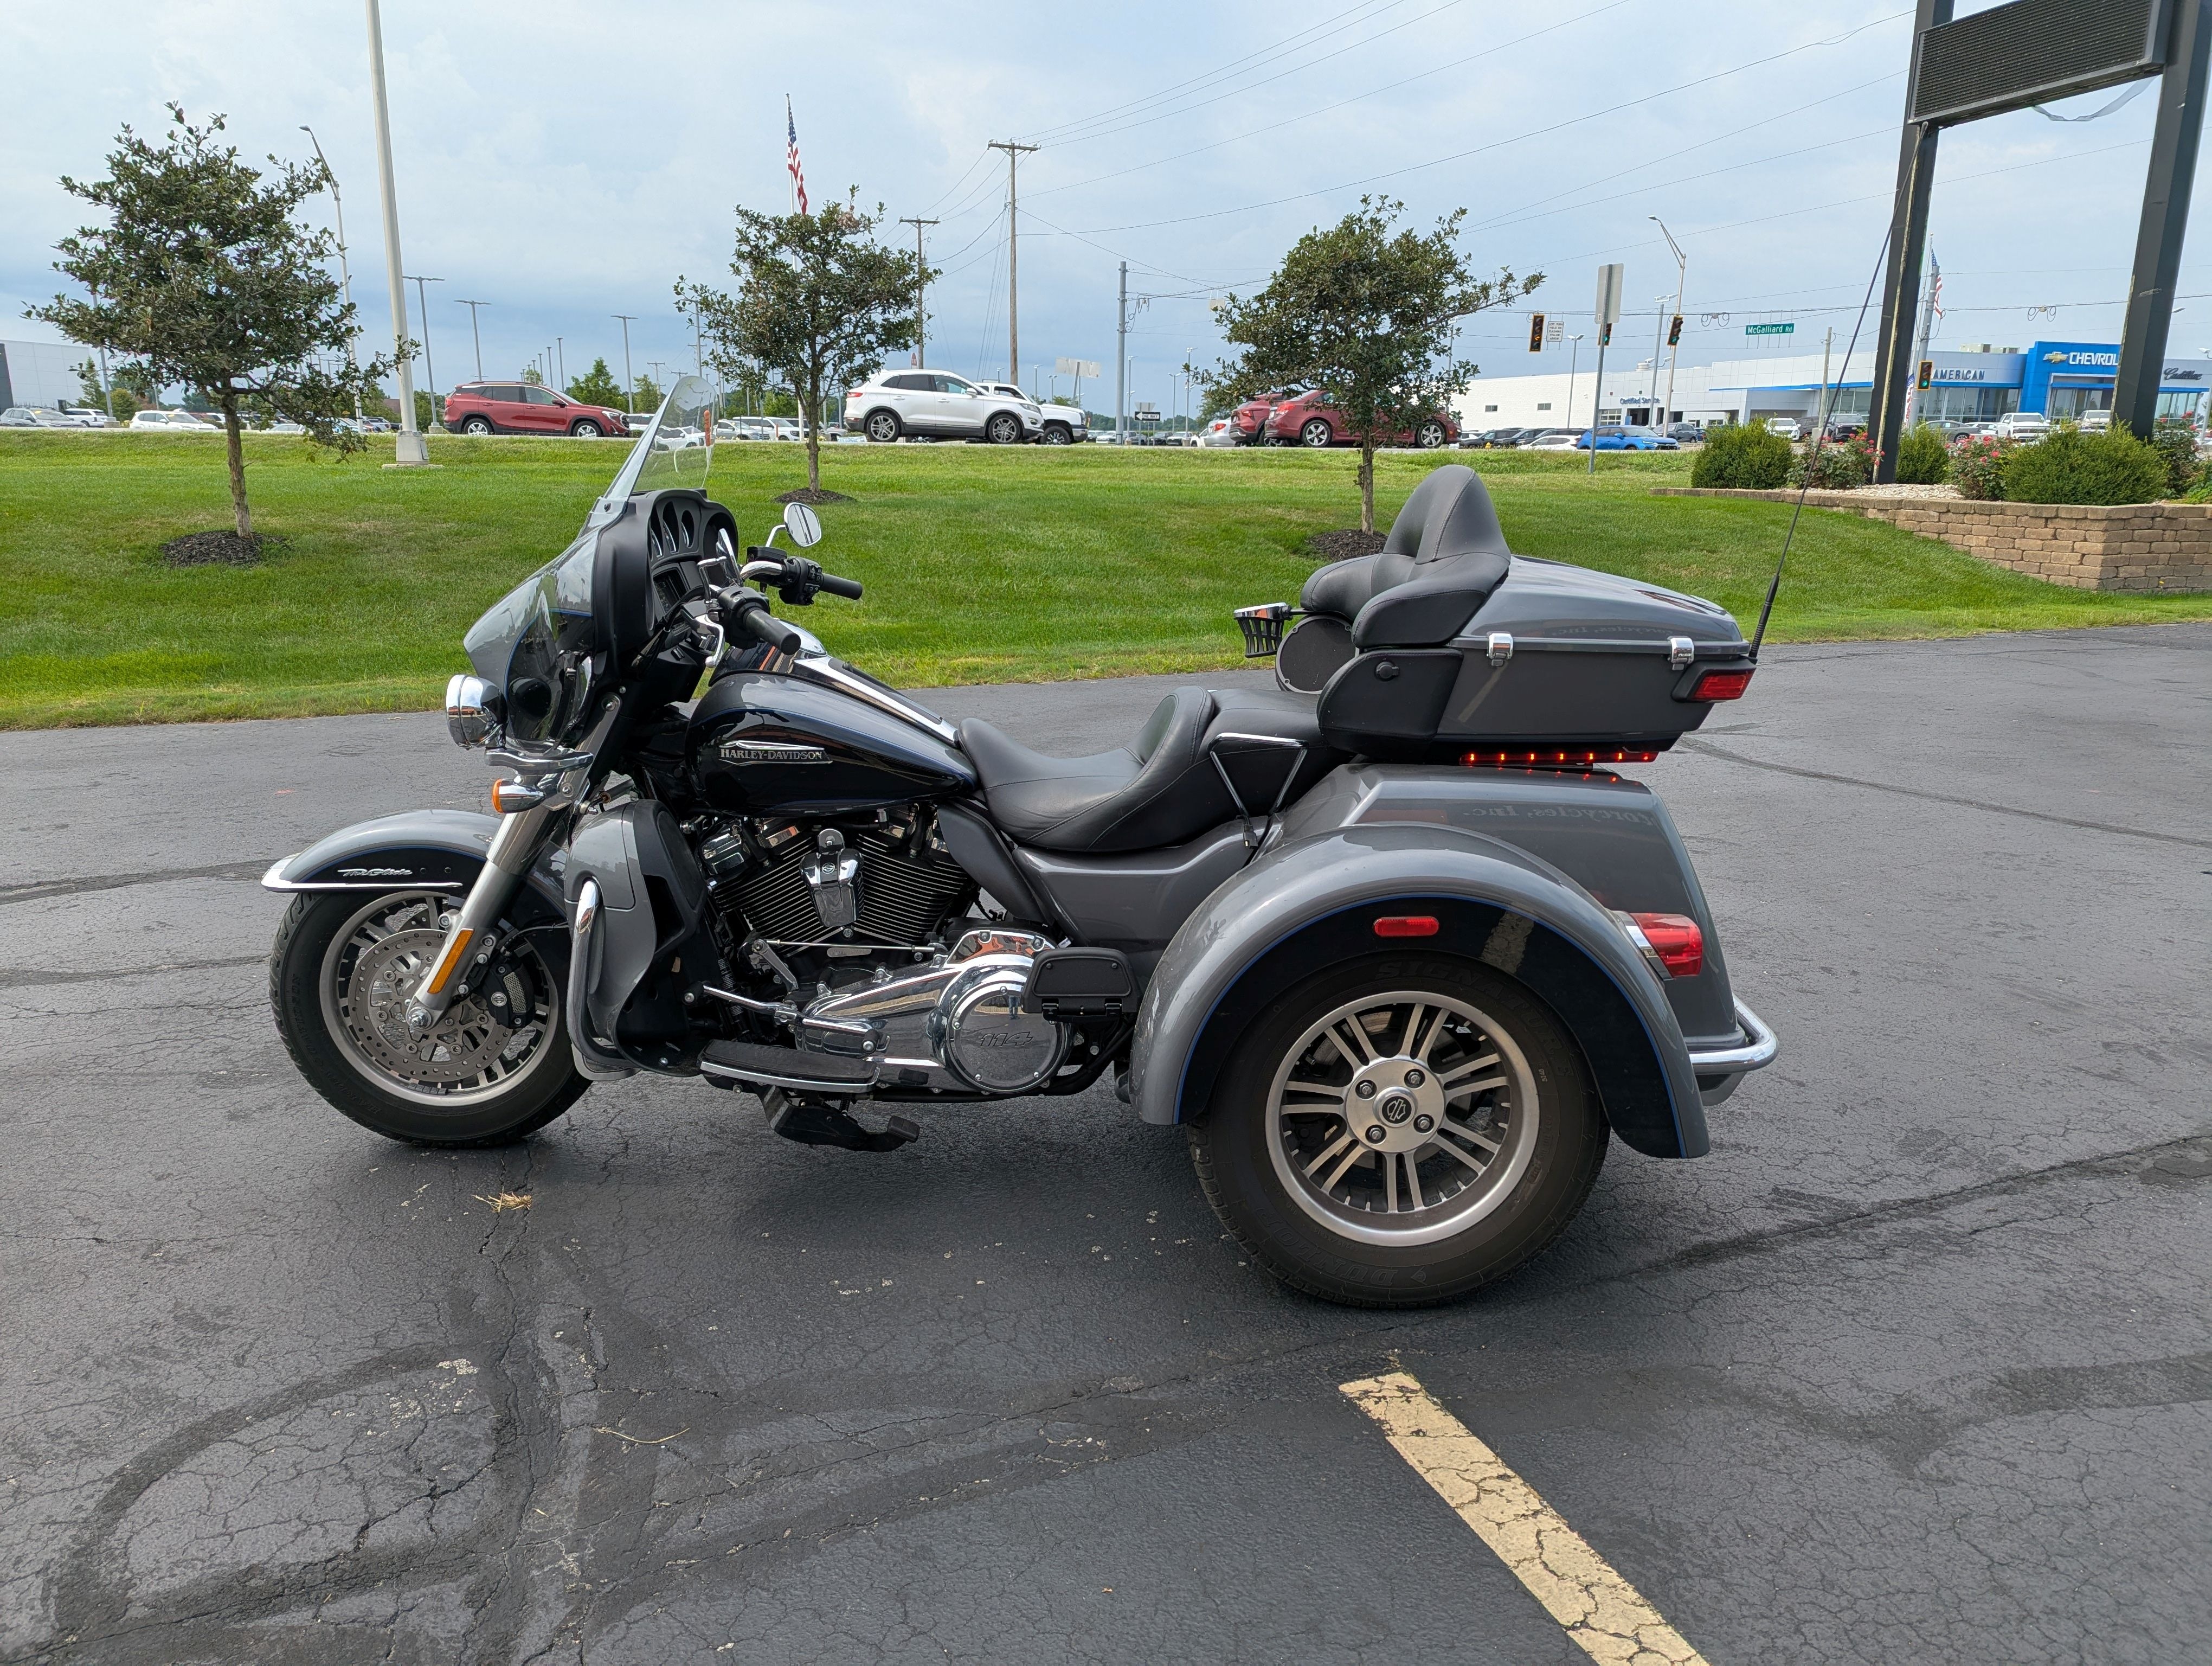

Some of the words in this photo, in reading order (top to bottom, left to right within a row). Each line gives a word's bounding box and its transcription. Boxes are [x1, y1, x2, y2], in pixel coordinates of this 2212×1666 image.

[1747, 325, 1783, 334] McGalliard
[2069, 352, 2119, 365] CHEVROL
[1933, 369, 1985, 380] AMERICAN
[2164, 367, 2203, 380] Cadillac
[721, 748, 822, 760] HARLEY-DAVIDSON
[1375, 960, 1574, 1077] SIGNATURE
[980, 1031, 1034, 1048] 114
[1254, 1207, 1399, 1286] DUNLOP
